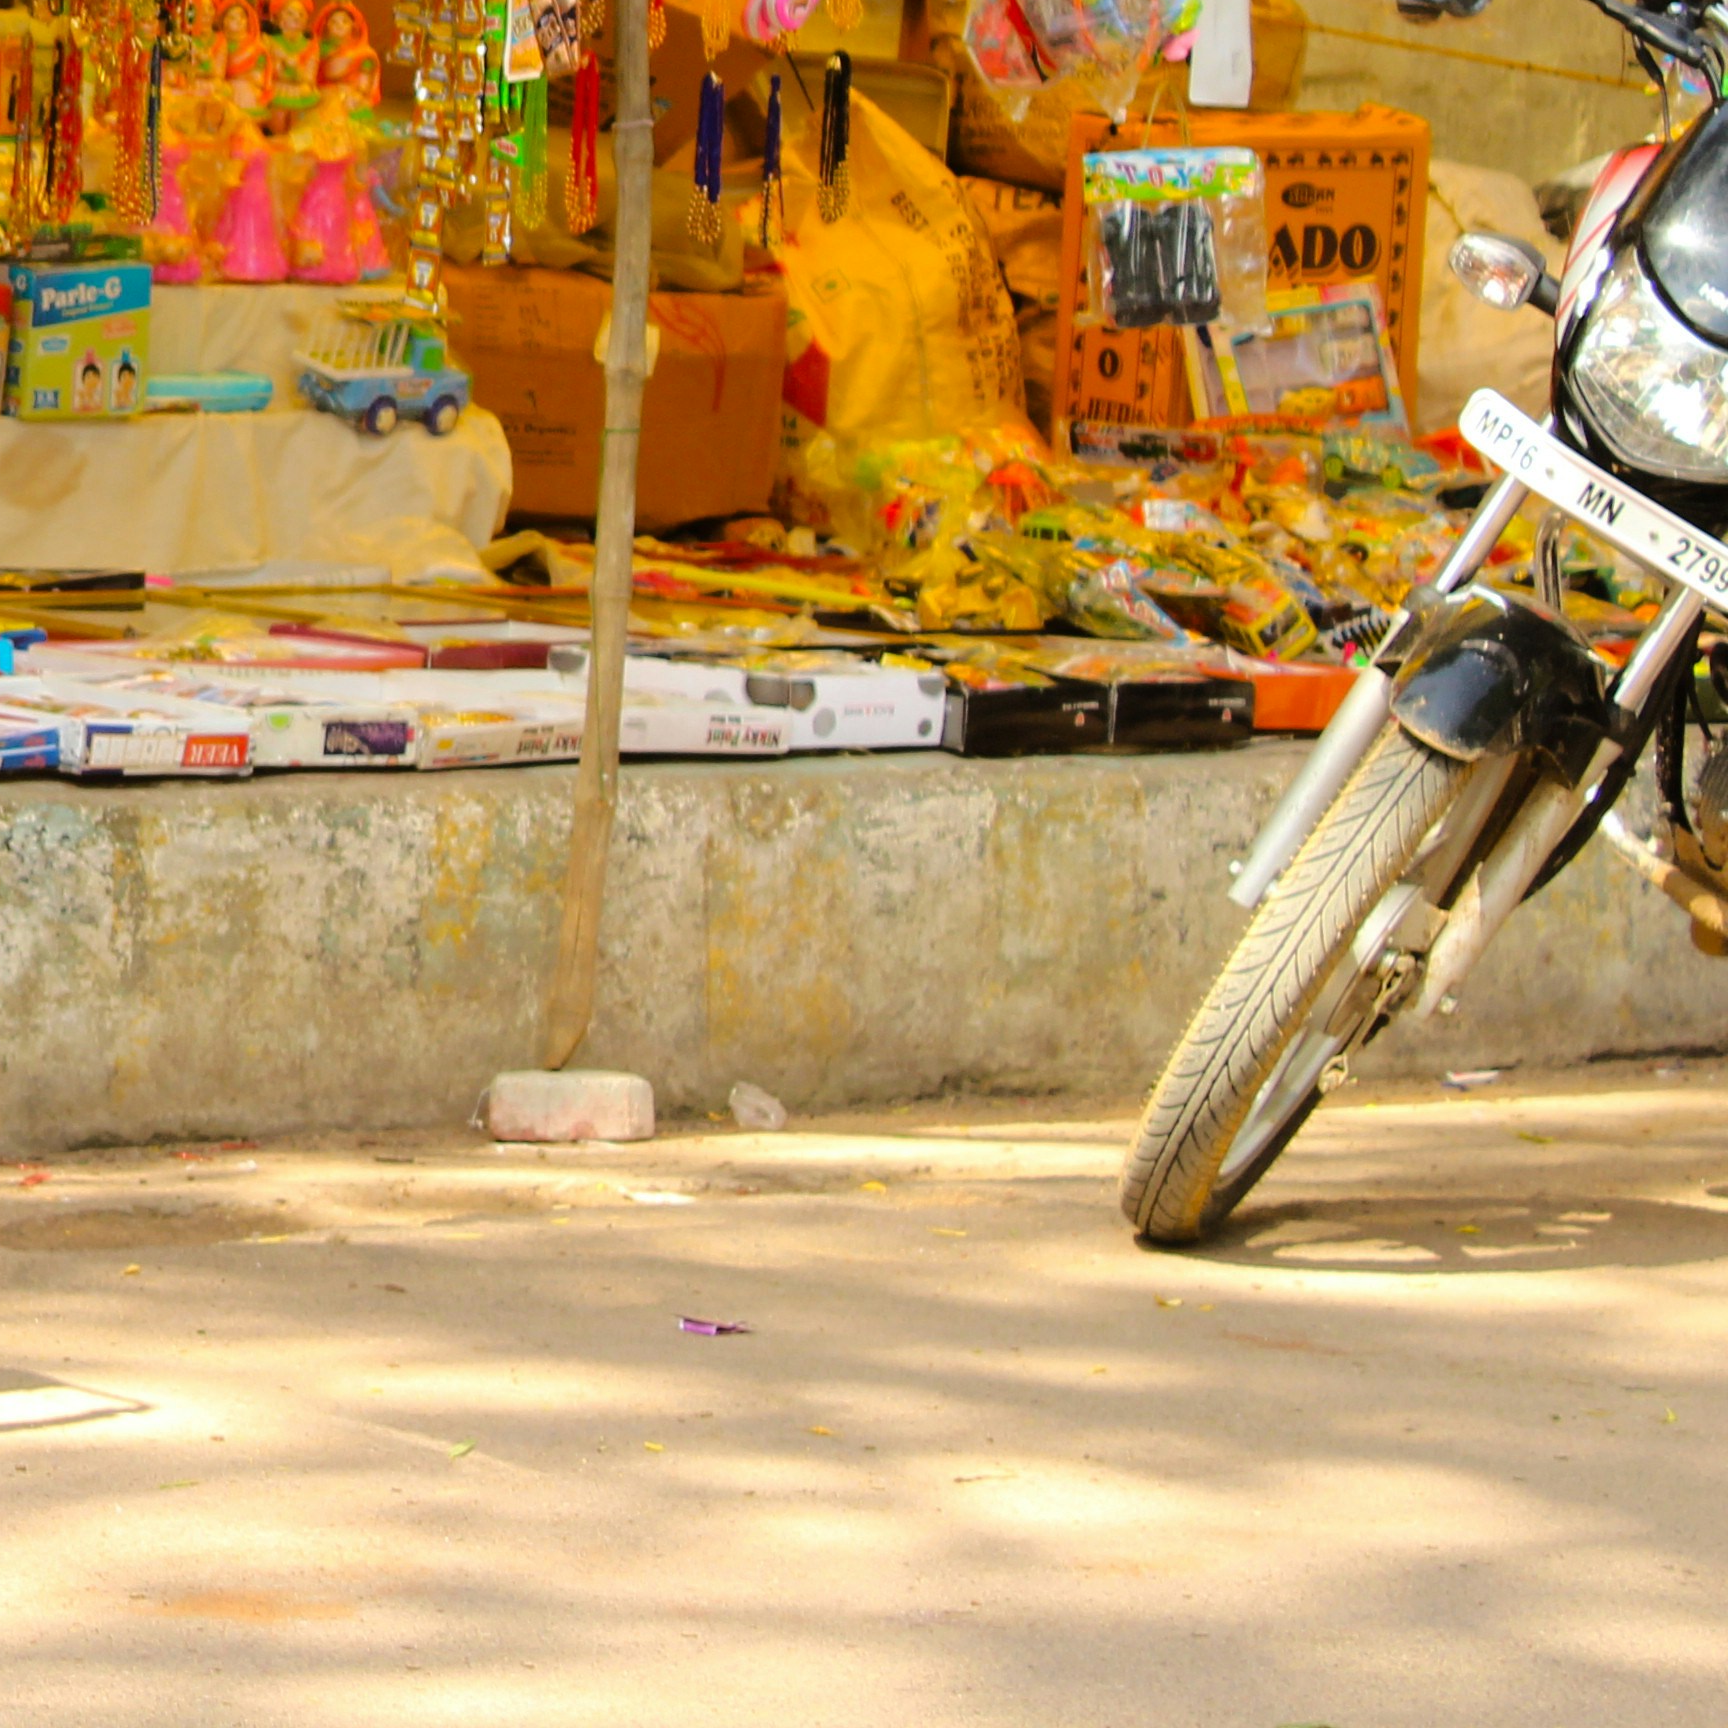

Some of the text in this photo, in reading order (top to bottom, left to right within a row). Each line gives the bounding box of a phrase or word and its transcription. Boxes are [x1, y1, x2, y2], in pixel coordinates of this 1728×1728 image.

[1116, 161, 1217, 189] TOYS
[41, 275, 122, 312] Parle-G
[1476, 406, 1539, 473] MP16
[1576, 481, 1625, 527] MN
[188, 743, 240, 764] VEER
[552, 733, 582, 751] ikky
